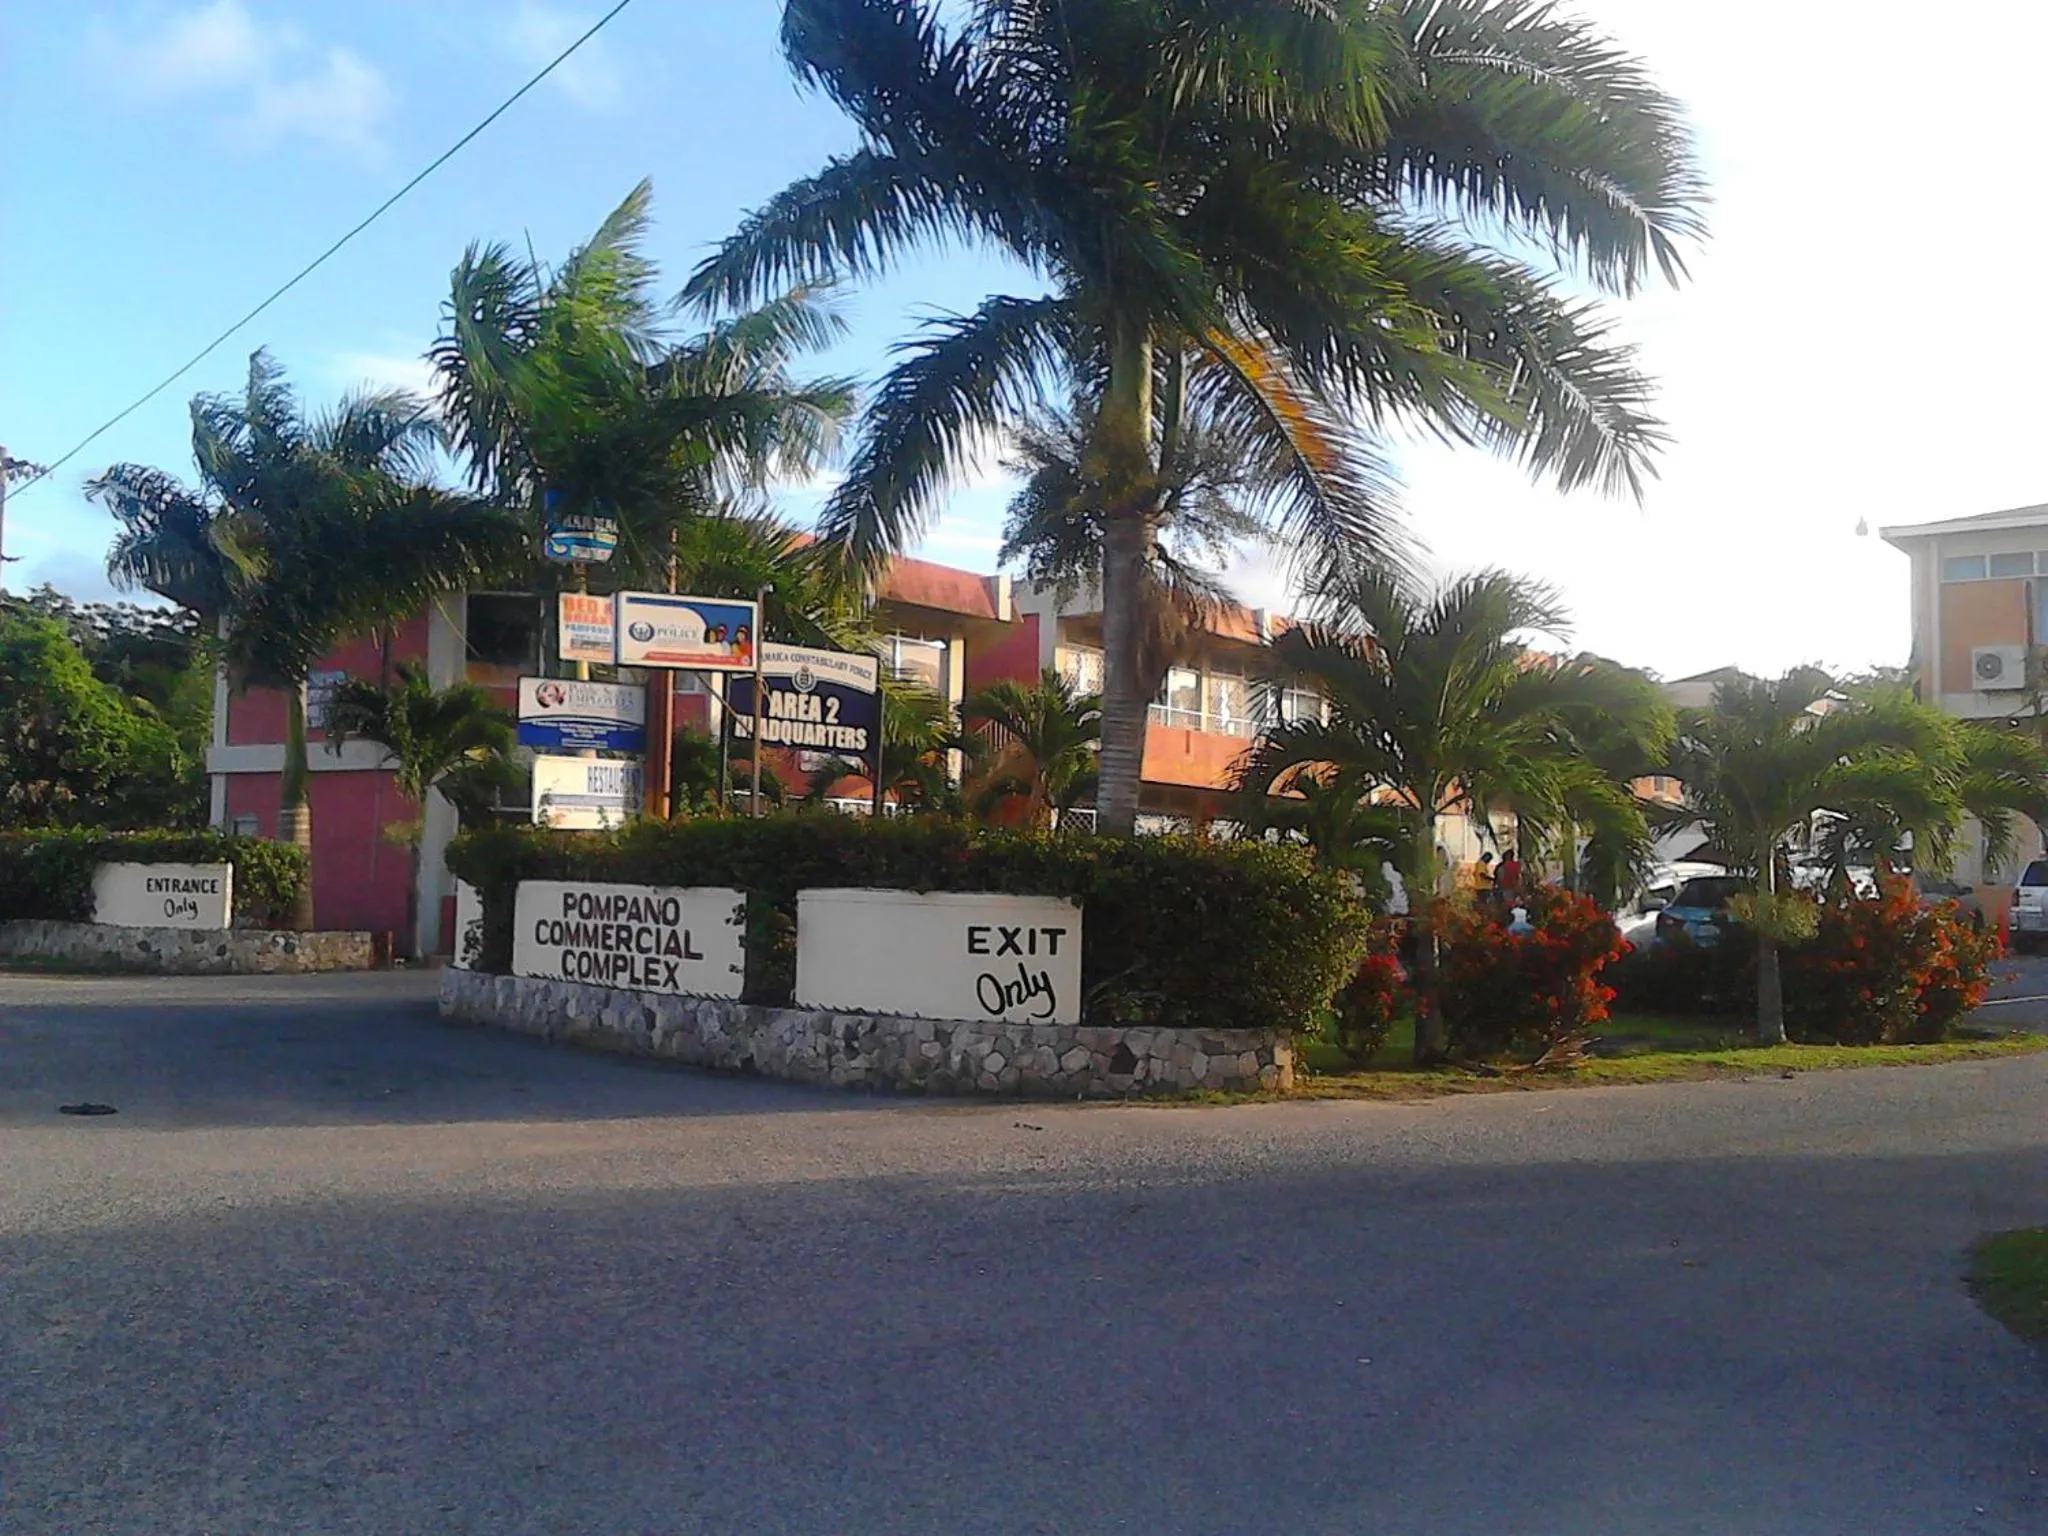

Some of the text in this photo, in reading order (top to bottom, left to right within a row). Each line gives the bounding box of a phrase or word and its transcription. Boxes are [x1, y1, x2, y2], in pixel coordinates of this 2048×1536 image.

[759, 651, 789, 662] AMAICA
[790, 651, 848, 671] CONSTABULARY
[849, 664, 873, 680] FORCE
[769, 690, 840, 724] AREA 2
[587, 765, 641, 794] RESTAUR
[146, 878, 219, 894] ENTRANCE
[164, 897, 199, 921] Only
[563, 892, 680, 926] POMPANO
[535, 919, 704, 960] COMMERCIAL
[967, 926, 1067, 956] EXIT
[561, 949, 680, 990] COMPLEX
[976, 962, 1056, 1018] Only
